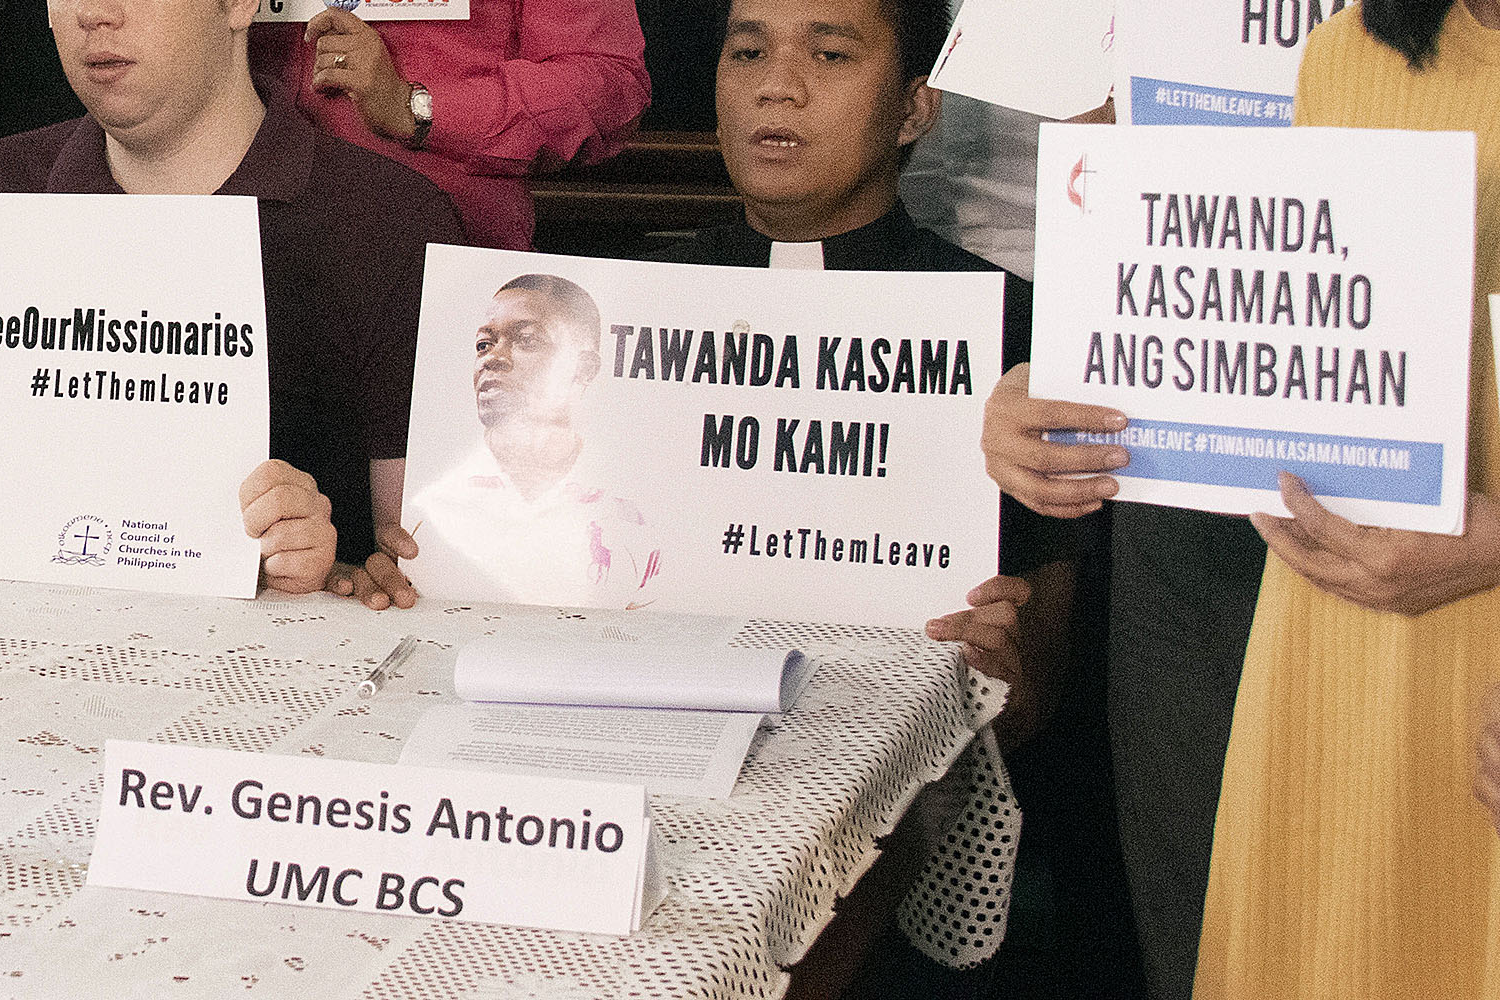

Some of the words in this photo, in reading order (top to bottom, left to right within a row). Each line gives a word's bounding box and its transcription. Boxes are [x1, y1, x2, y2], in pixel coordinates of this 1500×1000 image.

[1155, 86, 1261, 118] #LETTHEMLEAVE
[1140, 192, 1348, 261] TAWANDA,
[610, 323, 801, 391] TAWANDA
[816, 335, 974, 397] KASAMA
[30, 367, 230, 406] #LetThemLeave
[700, 413, 760, 471] MO
[773, 417, 891, 480] KAMI!
[120, 531, 160, 543] Council
[163, 535, 175, 544] of
[121, 519, 168, 531] National
[117, 557, 177, 570] Philippines
[118, 544, 168, 556] Churches
[170, 546, 181, 557] in
[184, 548, 202, 559] the
[722, 524, 952, 570] #LetThemLeave
[119, 768, 213, 816] Rev.
[230, 779, 412, 835] Genesis
[427, 798, 624, 854] Antonio
[245, 858, 363, 908] UMC
[375, 872, 466, 919] BCS
